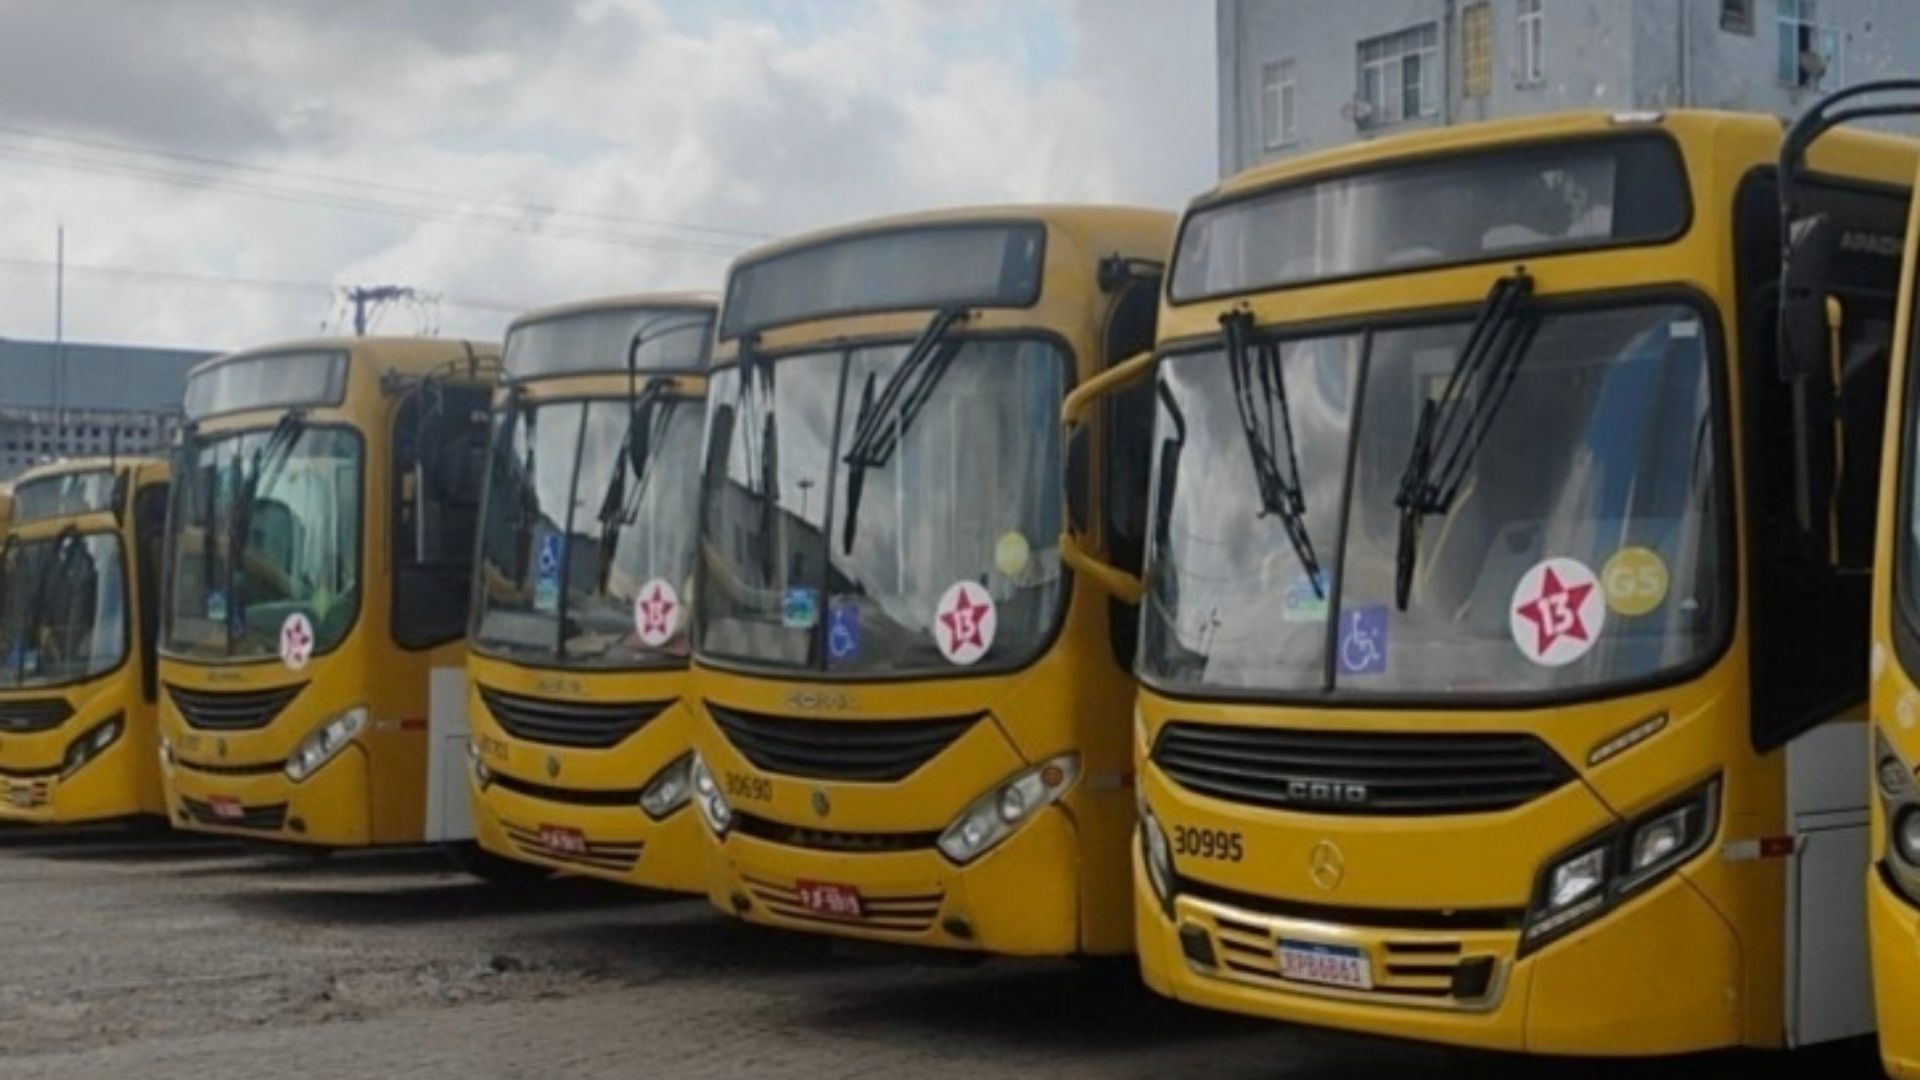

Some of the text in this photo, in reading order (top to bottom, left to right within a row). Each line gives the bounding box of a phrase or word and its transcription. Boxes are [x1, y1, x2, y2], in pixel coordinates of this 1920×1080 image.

[953, 608, 977, 641] 13
[1538, 591, 1575, 636] 13
[1174, 825, 1243, 862] 30995
